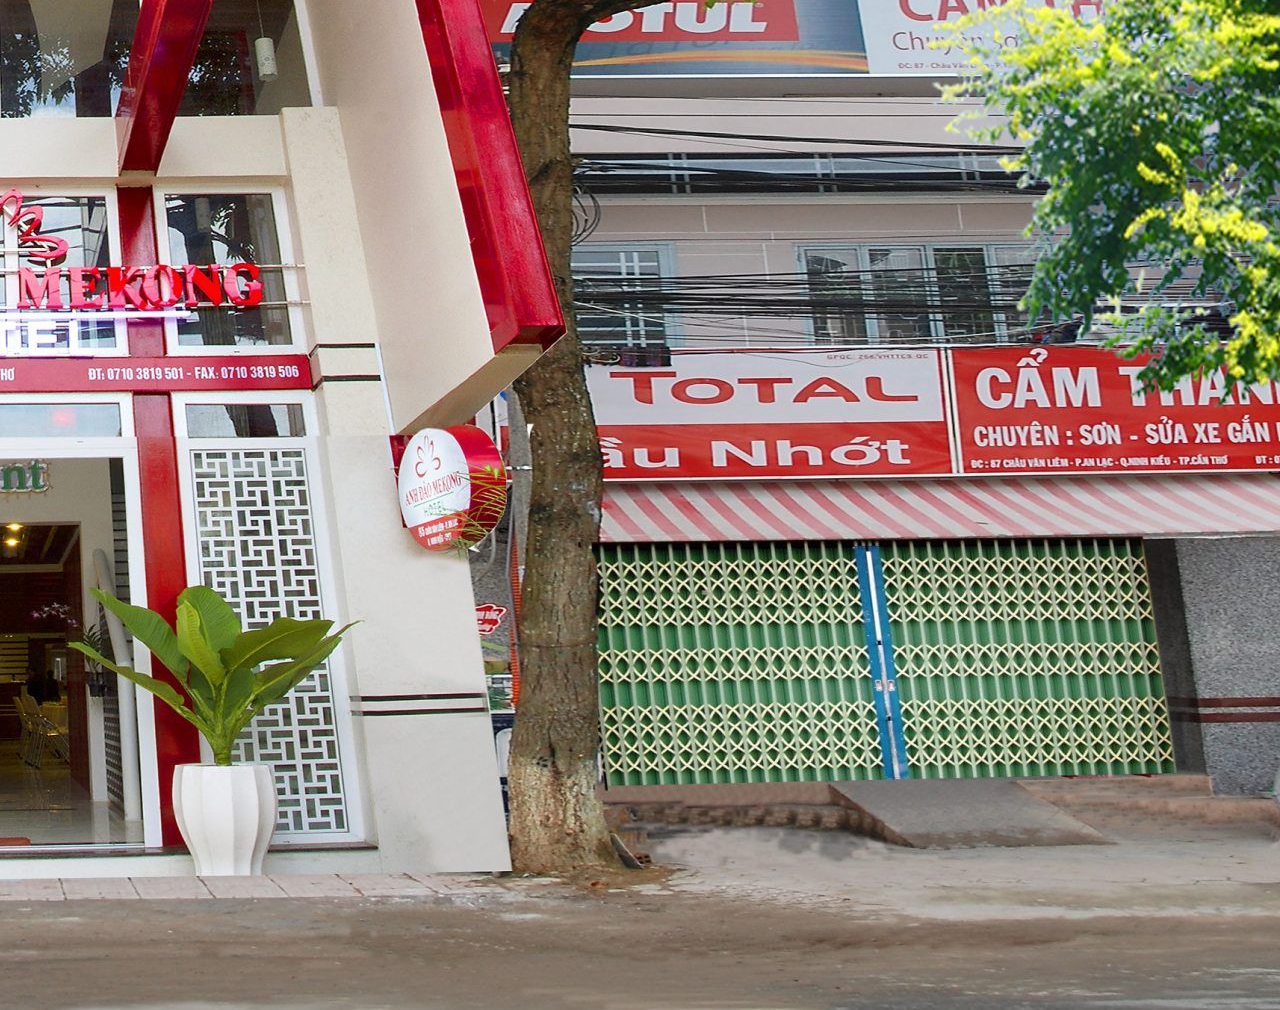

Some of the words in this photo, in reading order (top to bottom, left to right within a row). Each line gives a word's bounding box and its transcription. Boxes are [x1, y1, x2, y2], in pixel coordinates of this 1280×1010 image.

[17, 263, 266, 311] MEKONG
[107, 368, 134, 381] 0710
[136, 368, 163, 381] 3819
[165, 367, 184, 380] 501
[195, 367, 219, 380] FAX:
[221, 366, 247, 379] 0710
[250, 366, 276, 378] 3819
[278, 365, 299, 378] 506
[609, 371, 919, 405] TOTAL
[975, 348, 1102, 409] CẨM
[973, 420, 1059, 447] CHUYÊN
[1079, 421, 1122, 446] SƠN
[1145, 416, 1189, 444] SỬA
[1193, 422, 1222, 443] XE
[1227, 415, 1271, 443] GẮN
[600, 436, 681, 468] ầu
[711, 436, 911, 468] Nhớt
